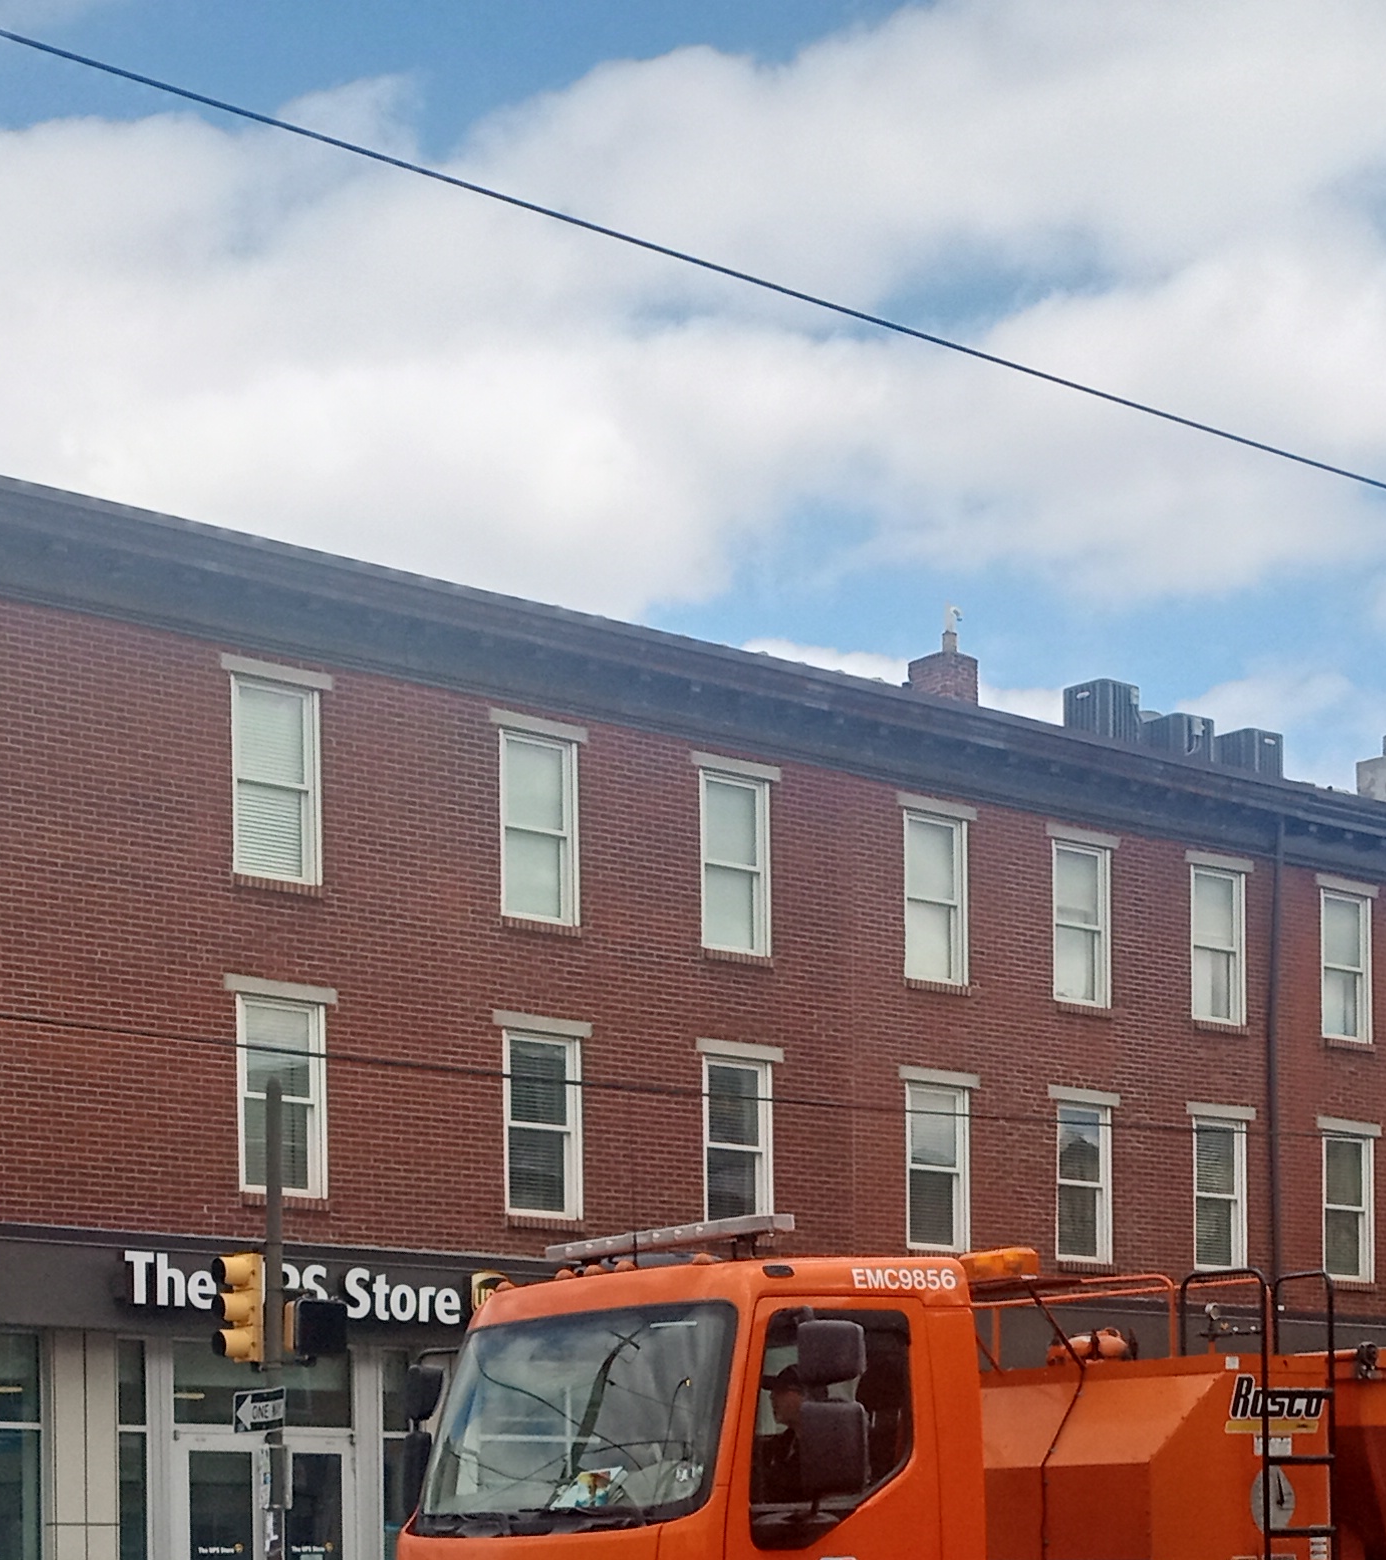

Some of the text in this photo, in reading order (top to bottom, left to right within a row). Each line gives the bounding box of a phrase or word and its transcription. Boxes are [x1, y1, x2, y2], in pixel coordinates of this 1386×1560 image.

[124, 1250, 217, 1309] The
[345, 1267, 461, 1325] Store
[851, 1268, 957, 1290] EMC9856
[252, 1403, 269, 1420] ONE
